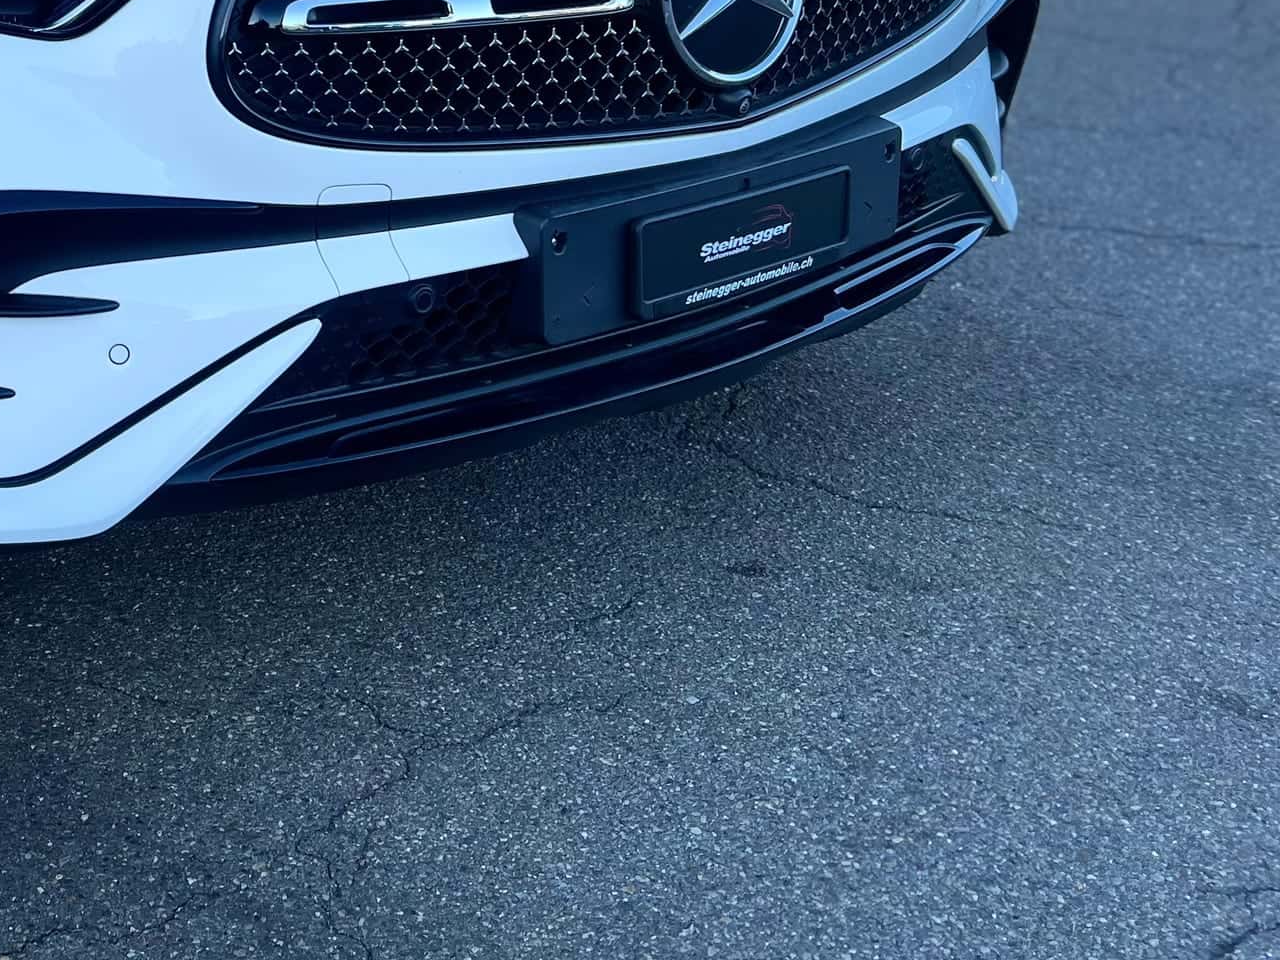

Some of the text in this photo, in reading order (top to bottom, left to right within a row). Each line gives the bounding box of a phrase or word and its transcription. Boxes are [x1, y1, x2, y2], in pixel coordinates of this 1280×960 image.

[700, 223, 791, 257] Steinegger
[704, 245, 751, 263] Automobile
[686, 257, 813, 304] steinegger-automobile.ch
